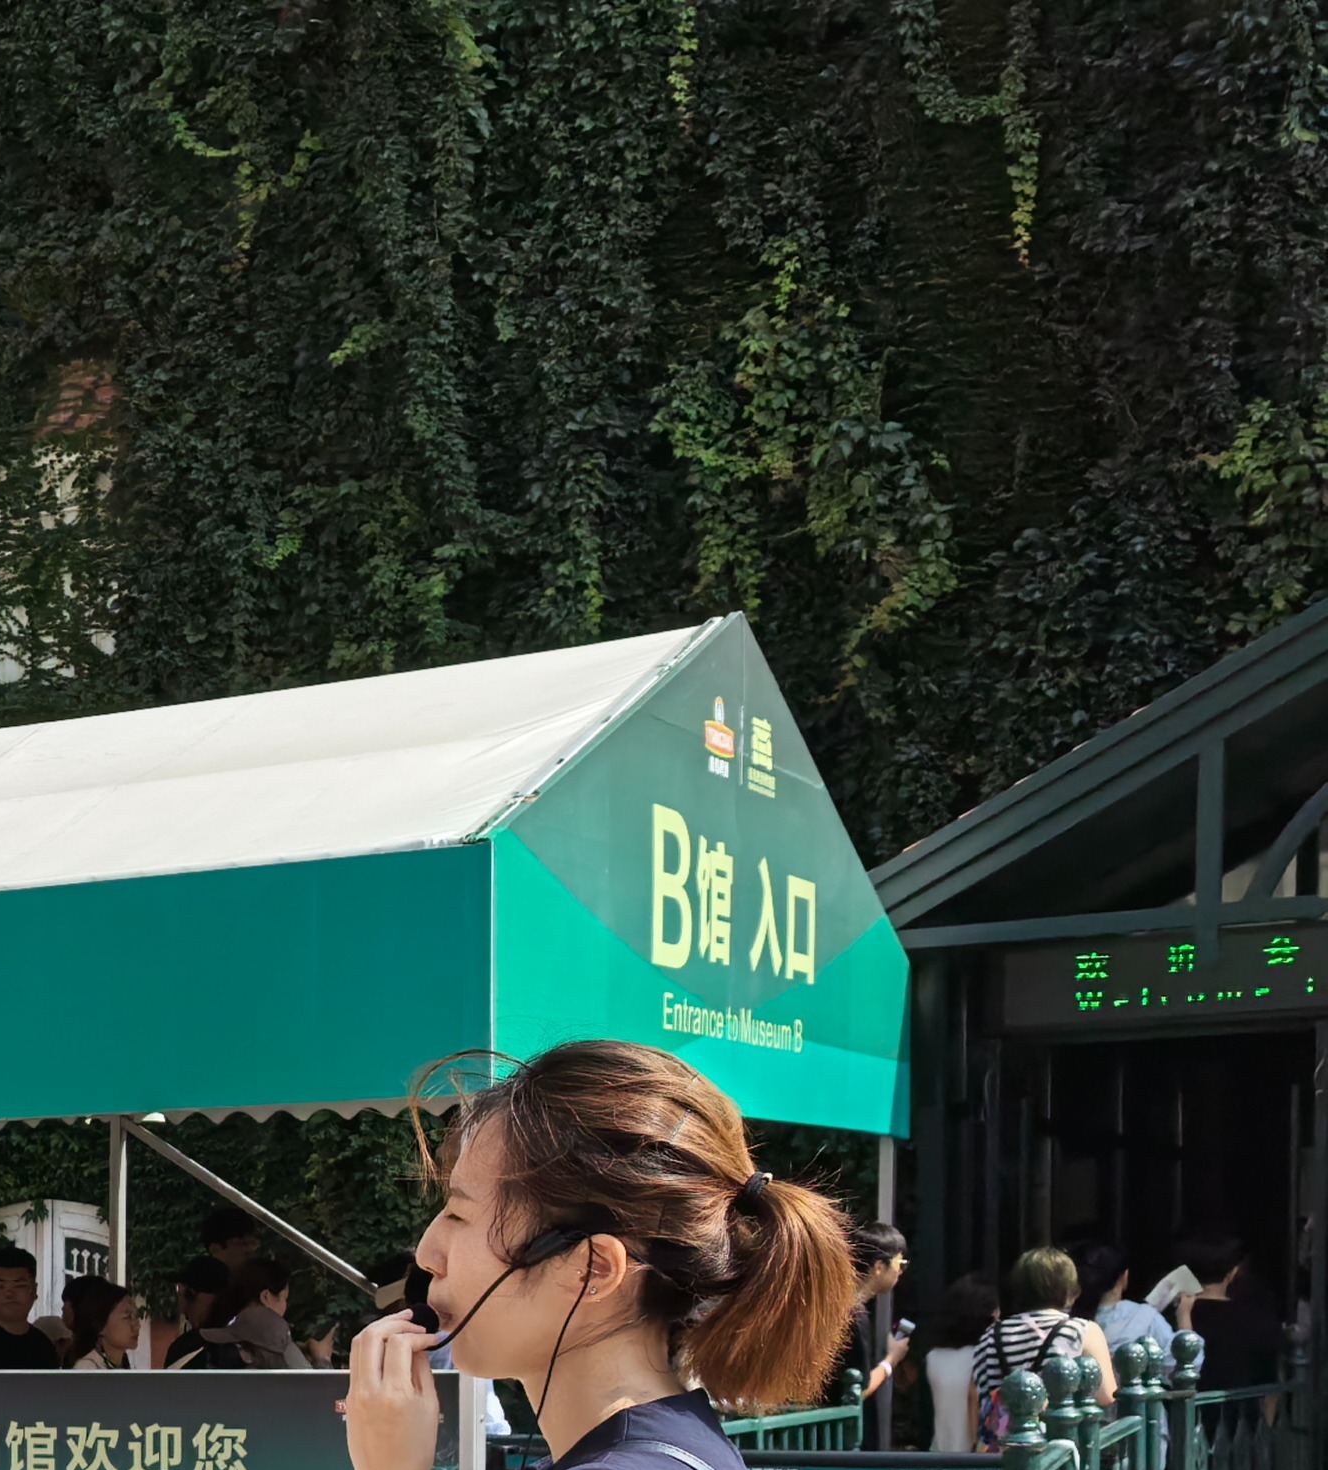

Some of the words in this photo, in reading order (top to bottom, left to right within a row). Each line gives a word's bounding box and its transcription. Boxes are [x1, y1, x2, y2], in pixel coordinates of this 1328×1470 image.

[749, 856, 817, 985] 入口
[663, 991, 724, 1039] Entrance
[726, 1006, 738, 1042] to
[740, 1008, 792, 1051] Museum
[794, 1018, 804, 1053] B
